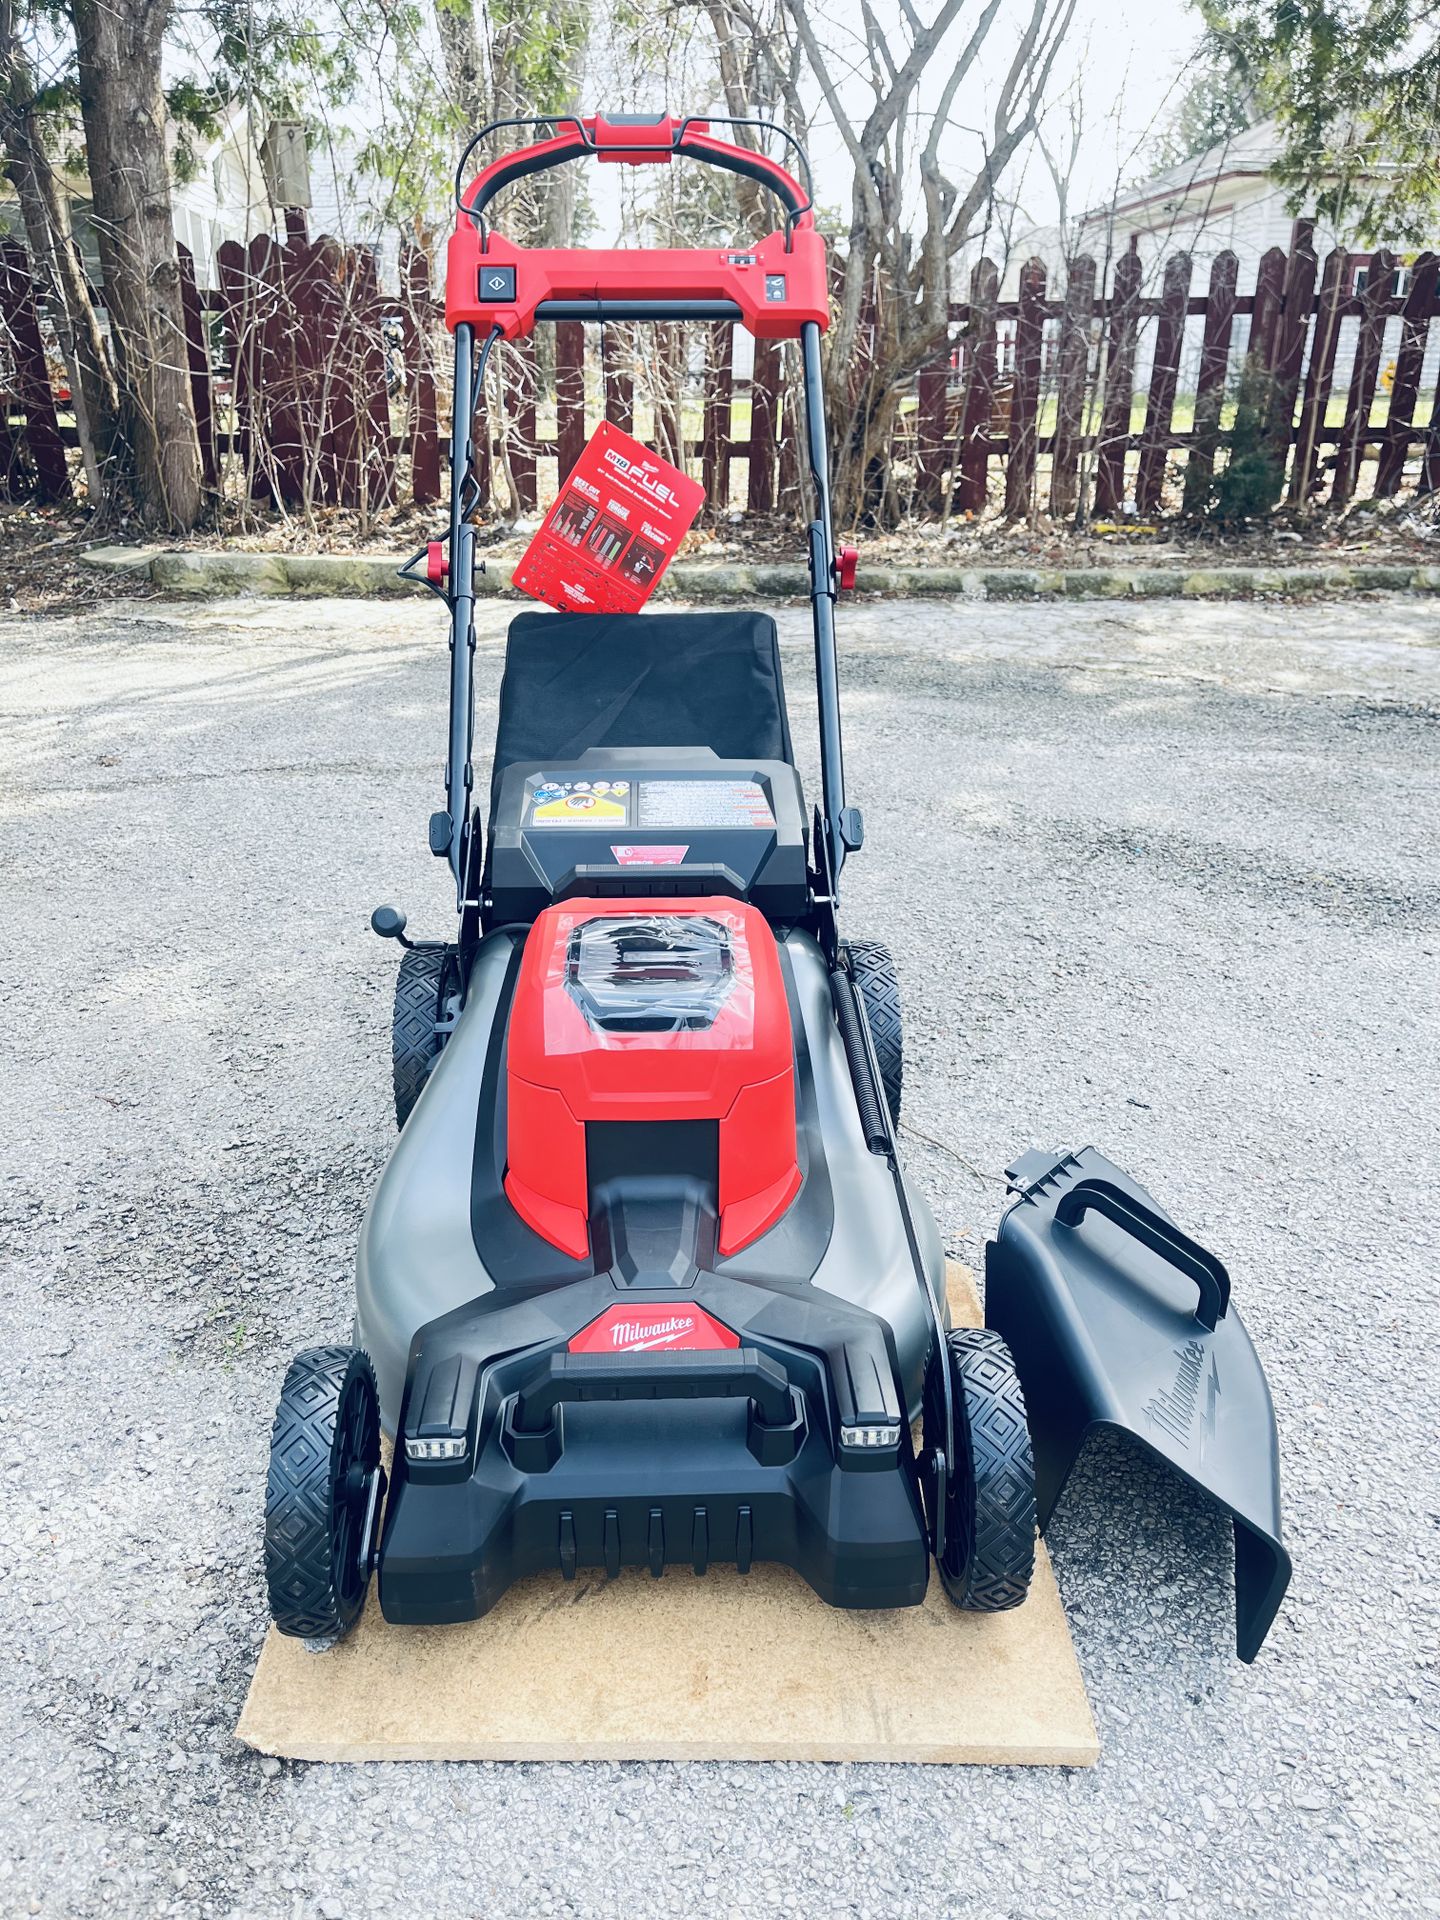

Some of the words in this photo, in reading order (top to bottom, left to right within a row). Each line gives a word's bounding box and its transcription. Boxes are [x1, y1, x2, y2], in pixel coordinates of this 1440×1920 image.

[605, 450, 628, 469] M18
[629, 465, 680, 508] FUEL
[609, 1297, 693, 1346] Milwaukee
[1141, 1340, 1205, 1449] Milwaukee
